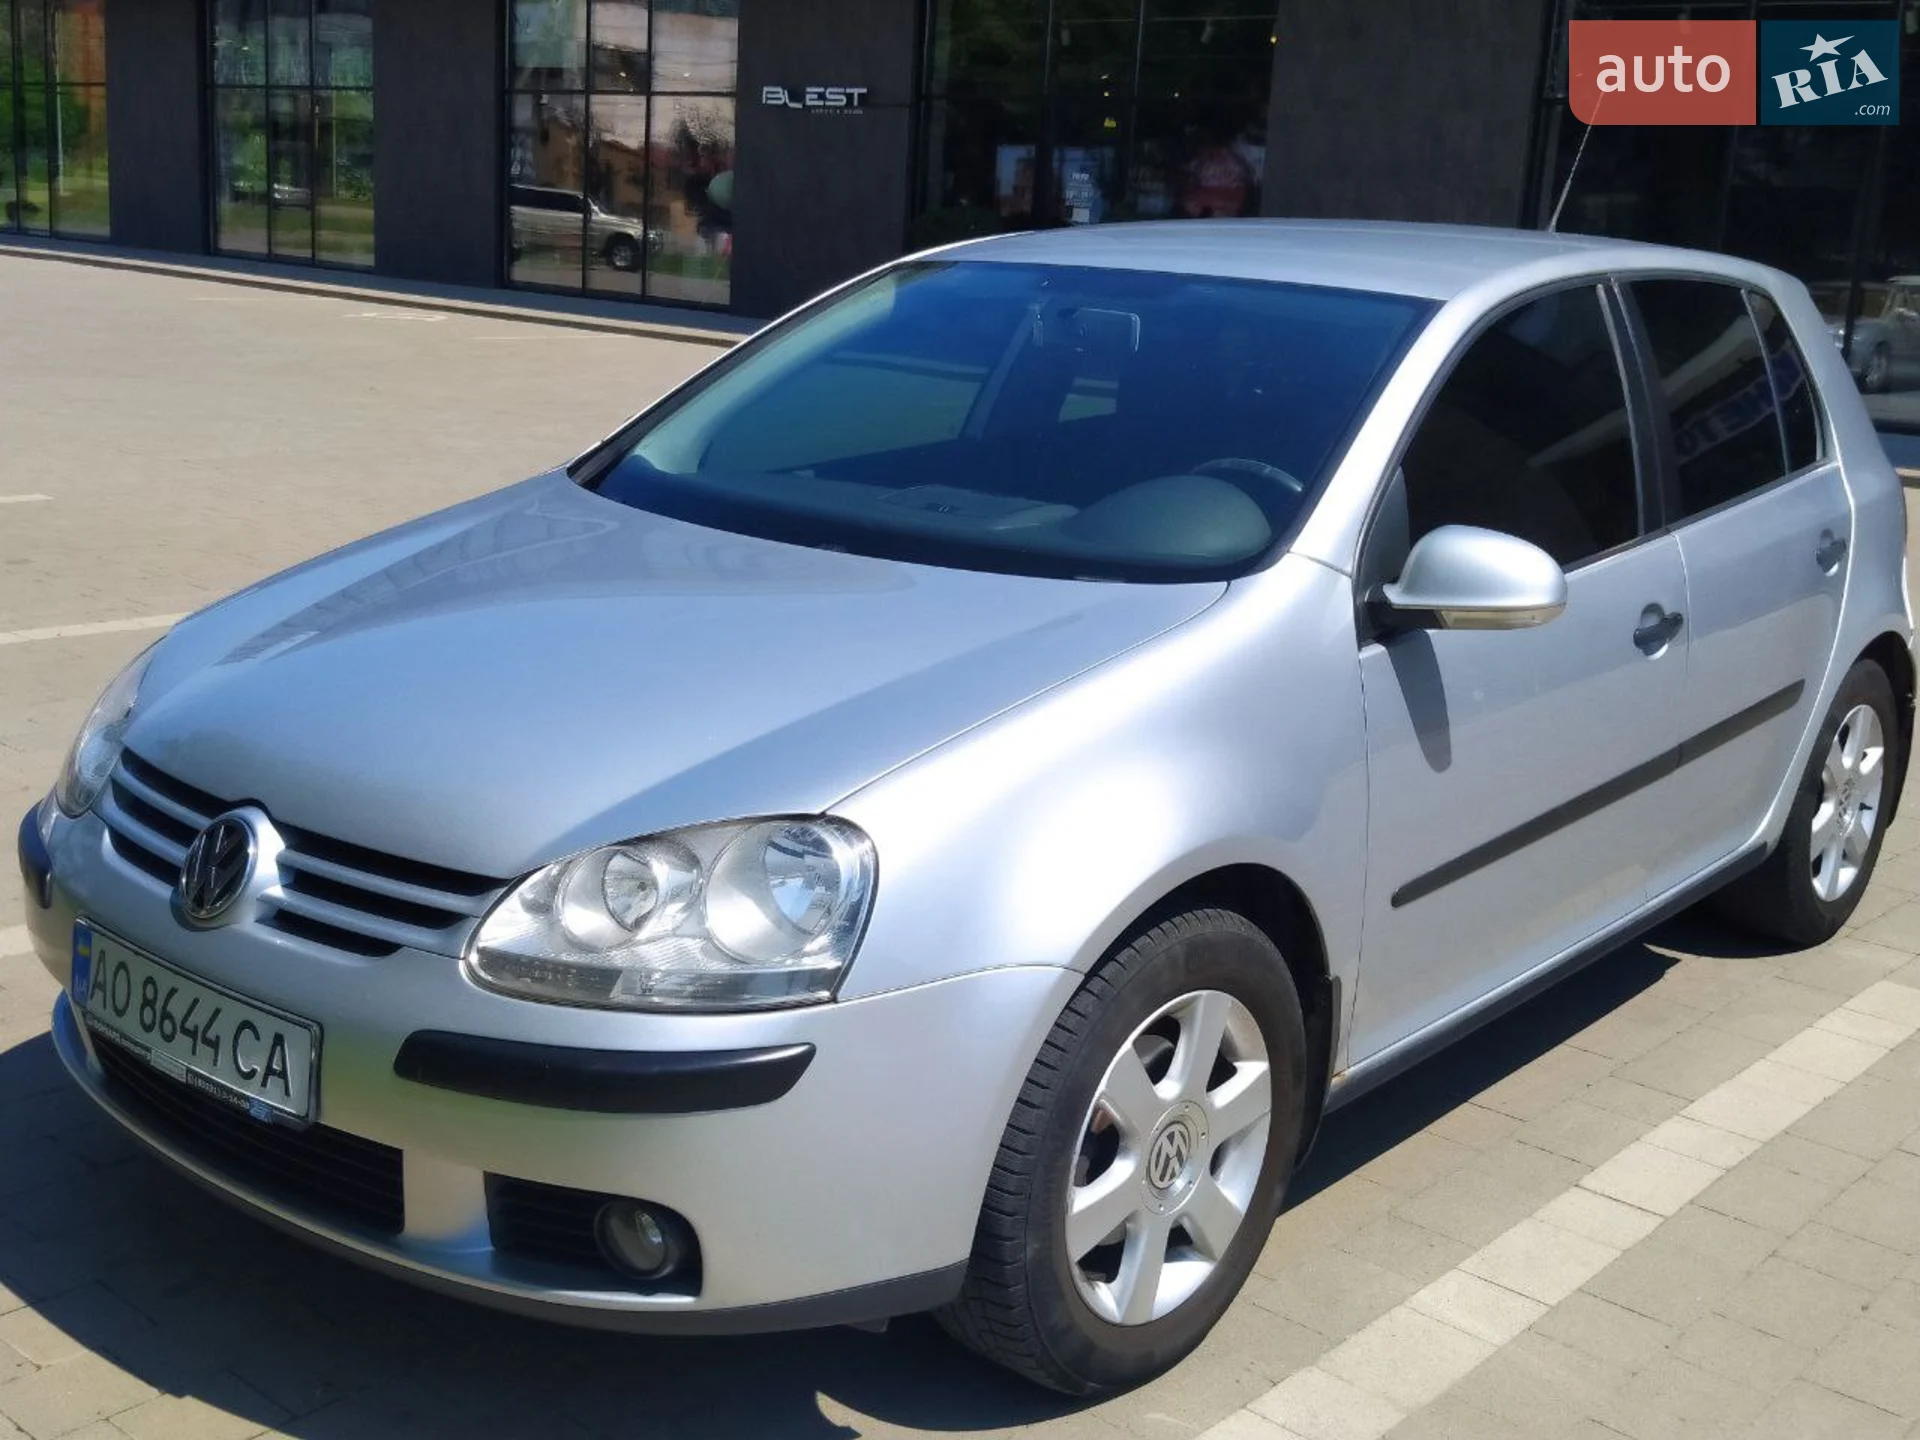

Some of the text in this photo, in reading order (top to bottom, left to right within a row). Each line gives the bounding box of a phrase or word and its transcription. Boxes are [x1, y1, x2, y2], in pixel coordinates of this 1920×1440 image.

[762, 86, 868, 109] BLEST
[90, 948, 131, 1018] AO
[139, 975, 222, 1068] 8644
[232, 1019, 293, 1097] CA
